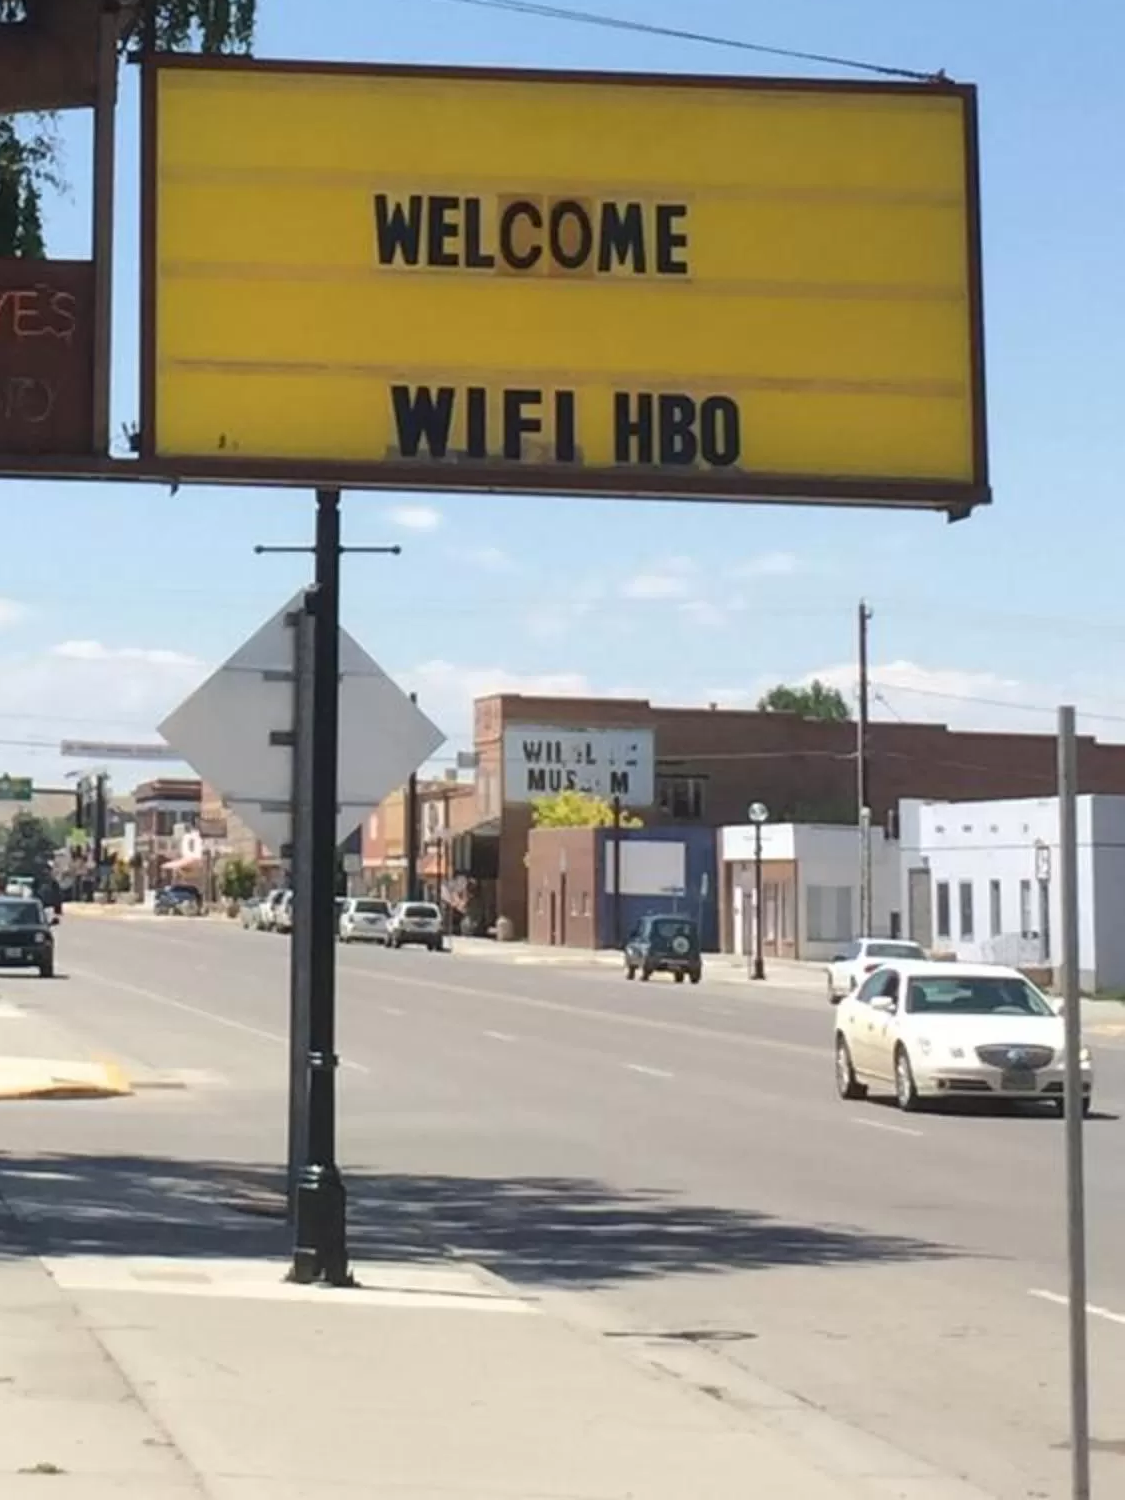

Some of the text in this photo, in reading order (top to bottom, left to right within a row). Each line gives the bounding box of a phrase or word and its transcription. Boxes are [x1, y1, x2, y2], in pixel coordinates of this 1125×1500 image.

[374, 194, 689, 275] WELCOME
[391, 385, 740, 467] WIFI HBO
[527, 767, 630, 795] MUSM
